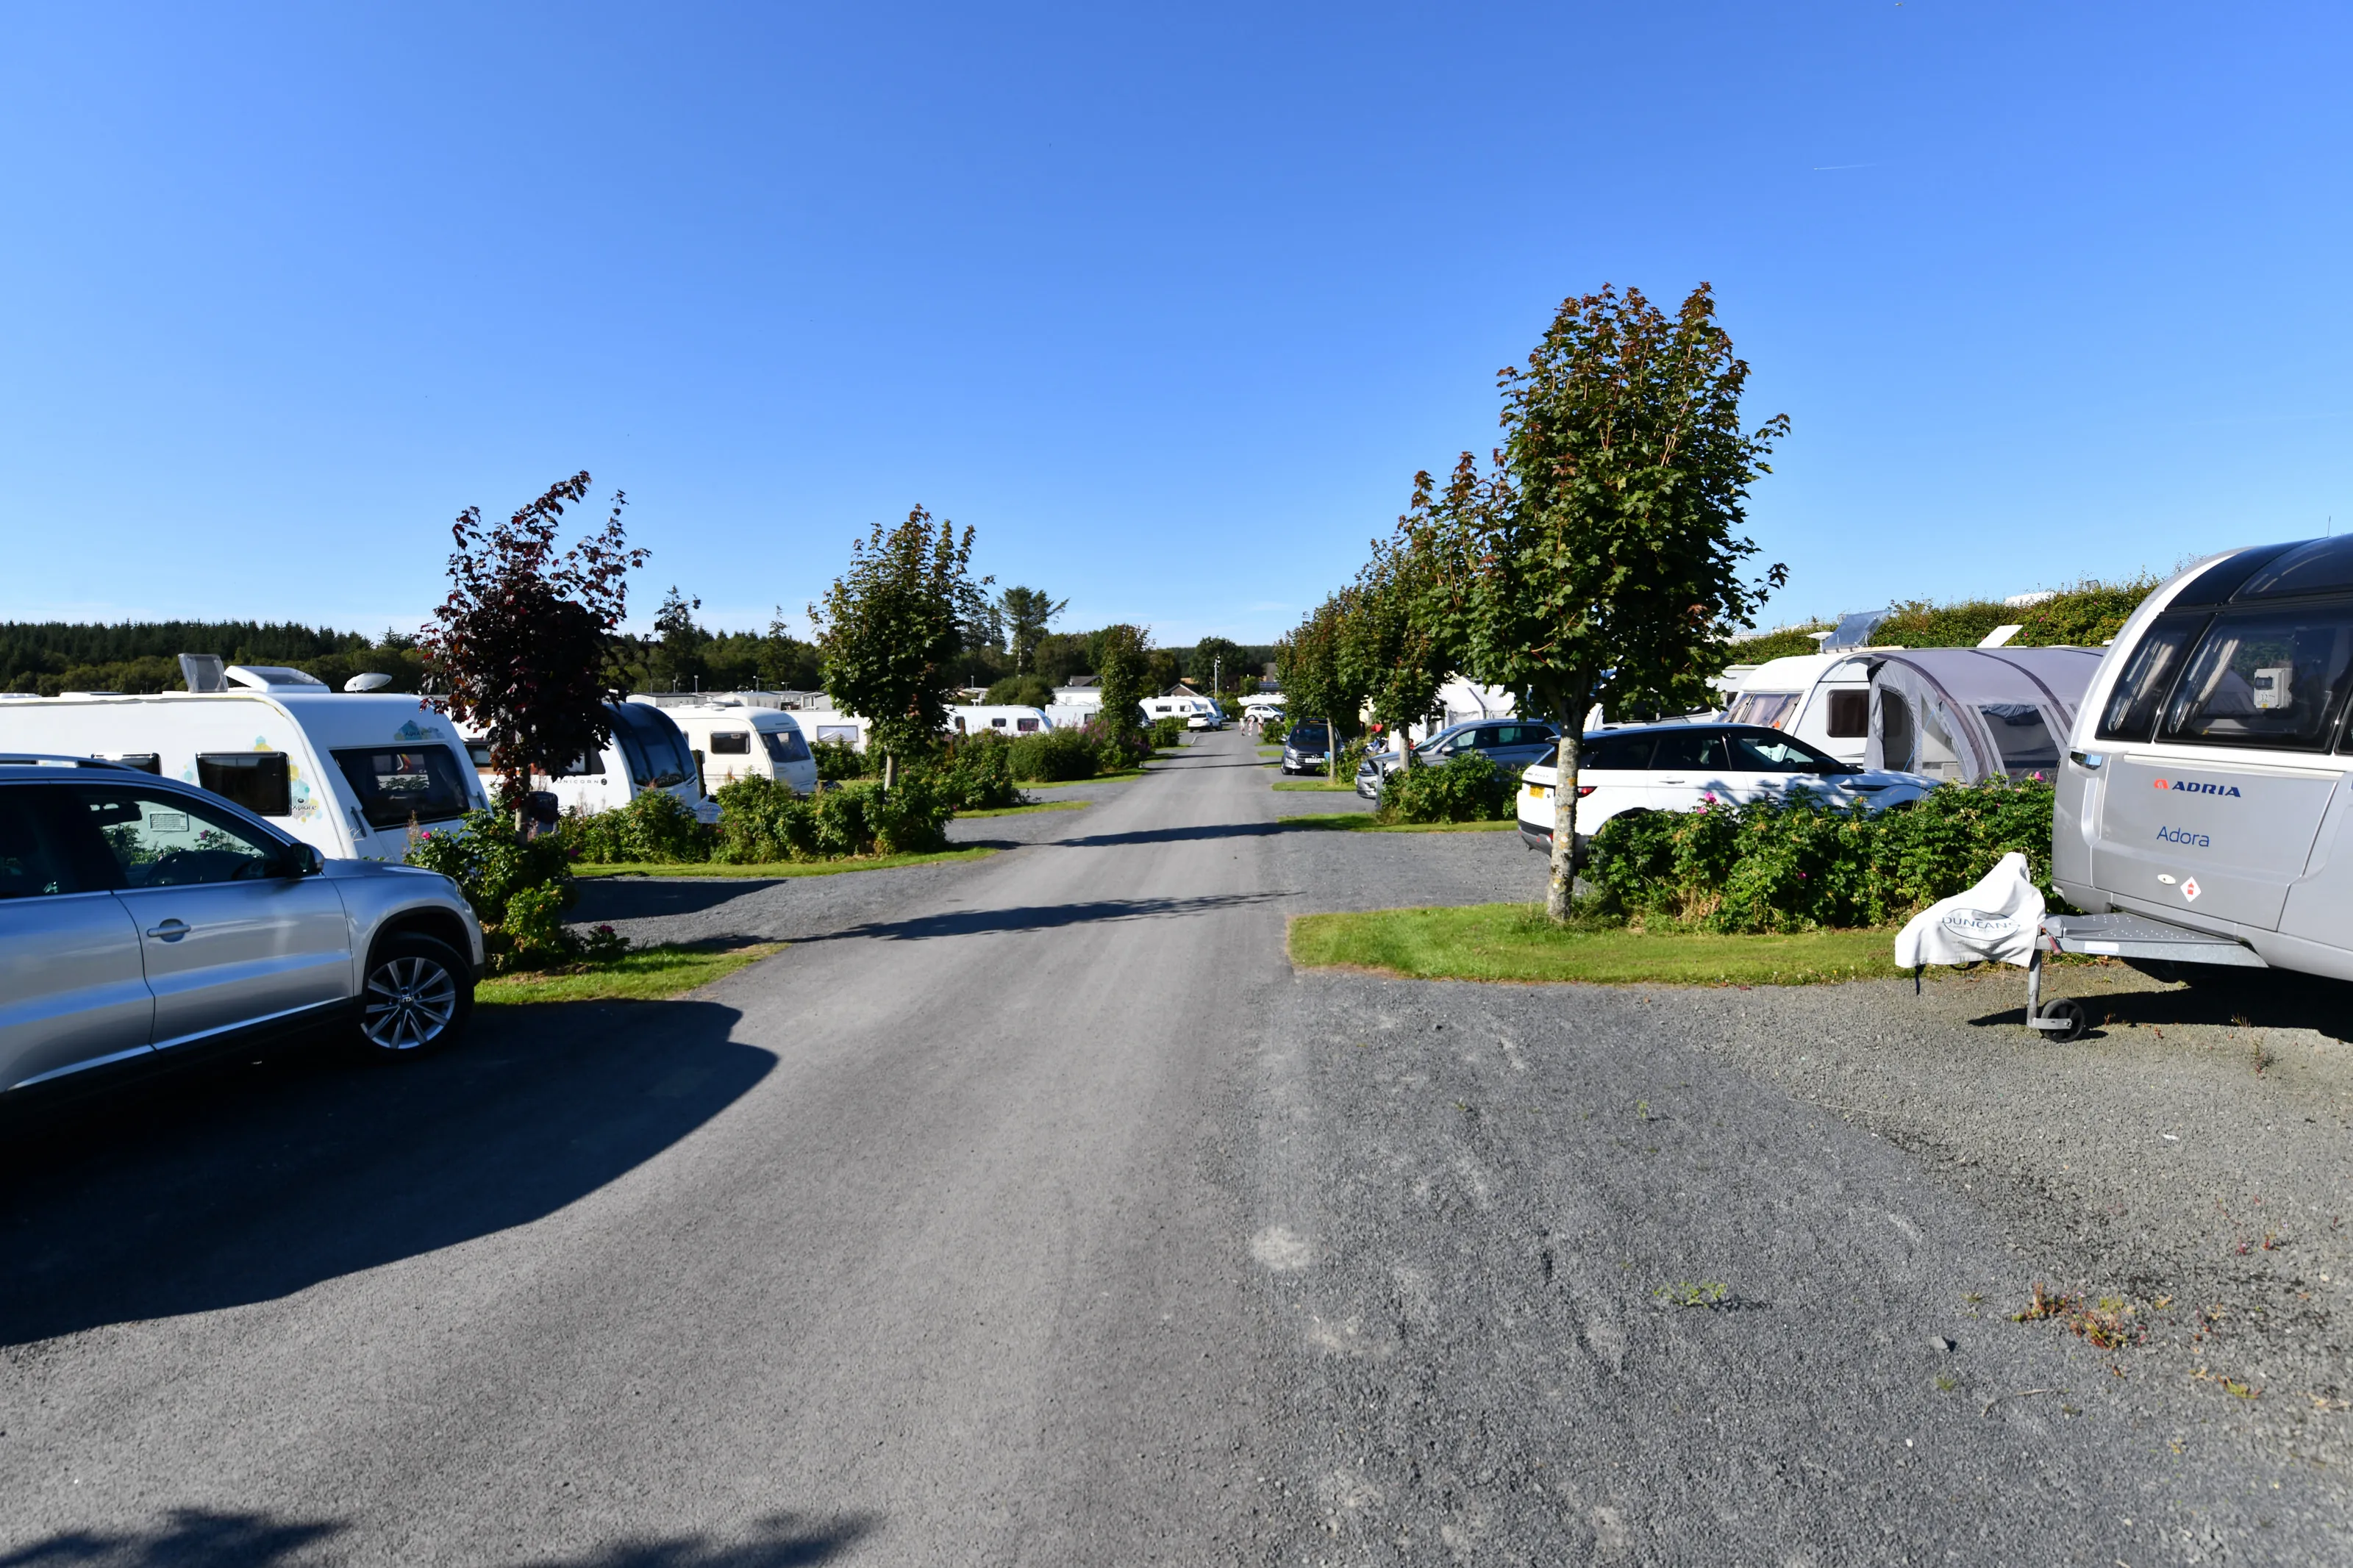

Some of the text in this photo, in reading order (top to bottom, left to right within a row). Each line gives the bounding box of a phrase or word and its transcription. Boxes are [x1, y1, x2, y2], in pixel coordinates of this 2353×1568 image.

[2171, 781, 2241, 798] ADRIA
[2156, 826, 2210, 848] Adora
[1941, 917, 2021, 929] DUNCANS
